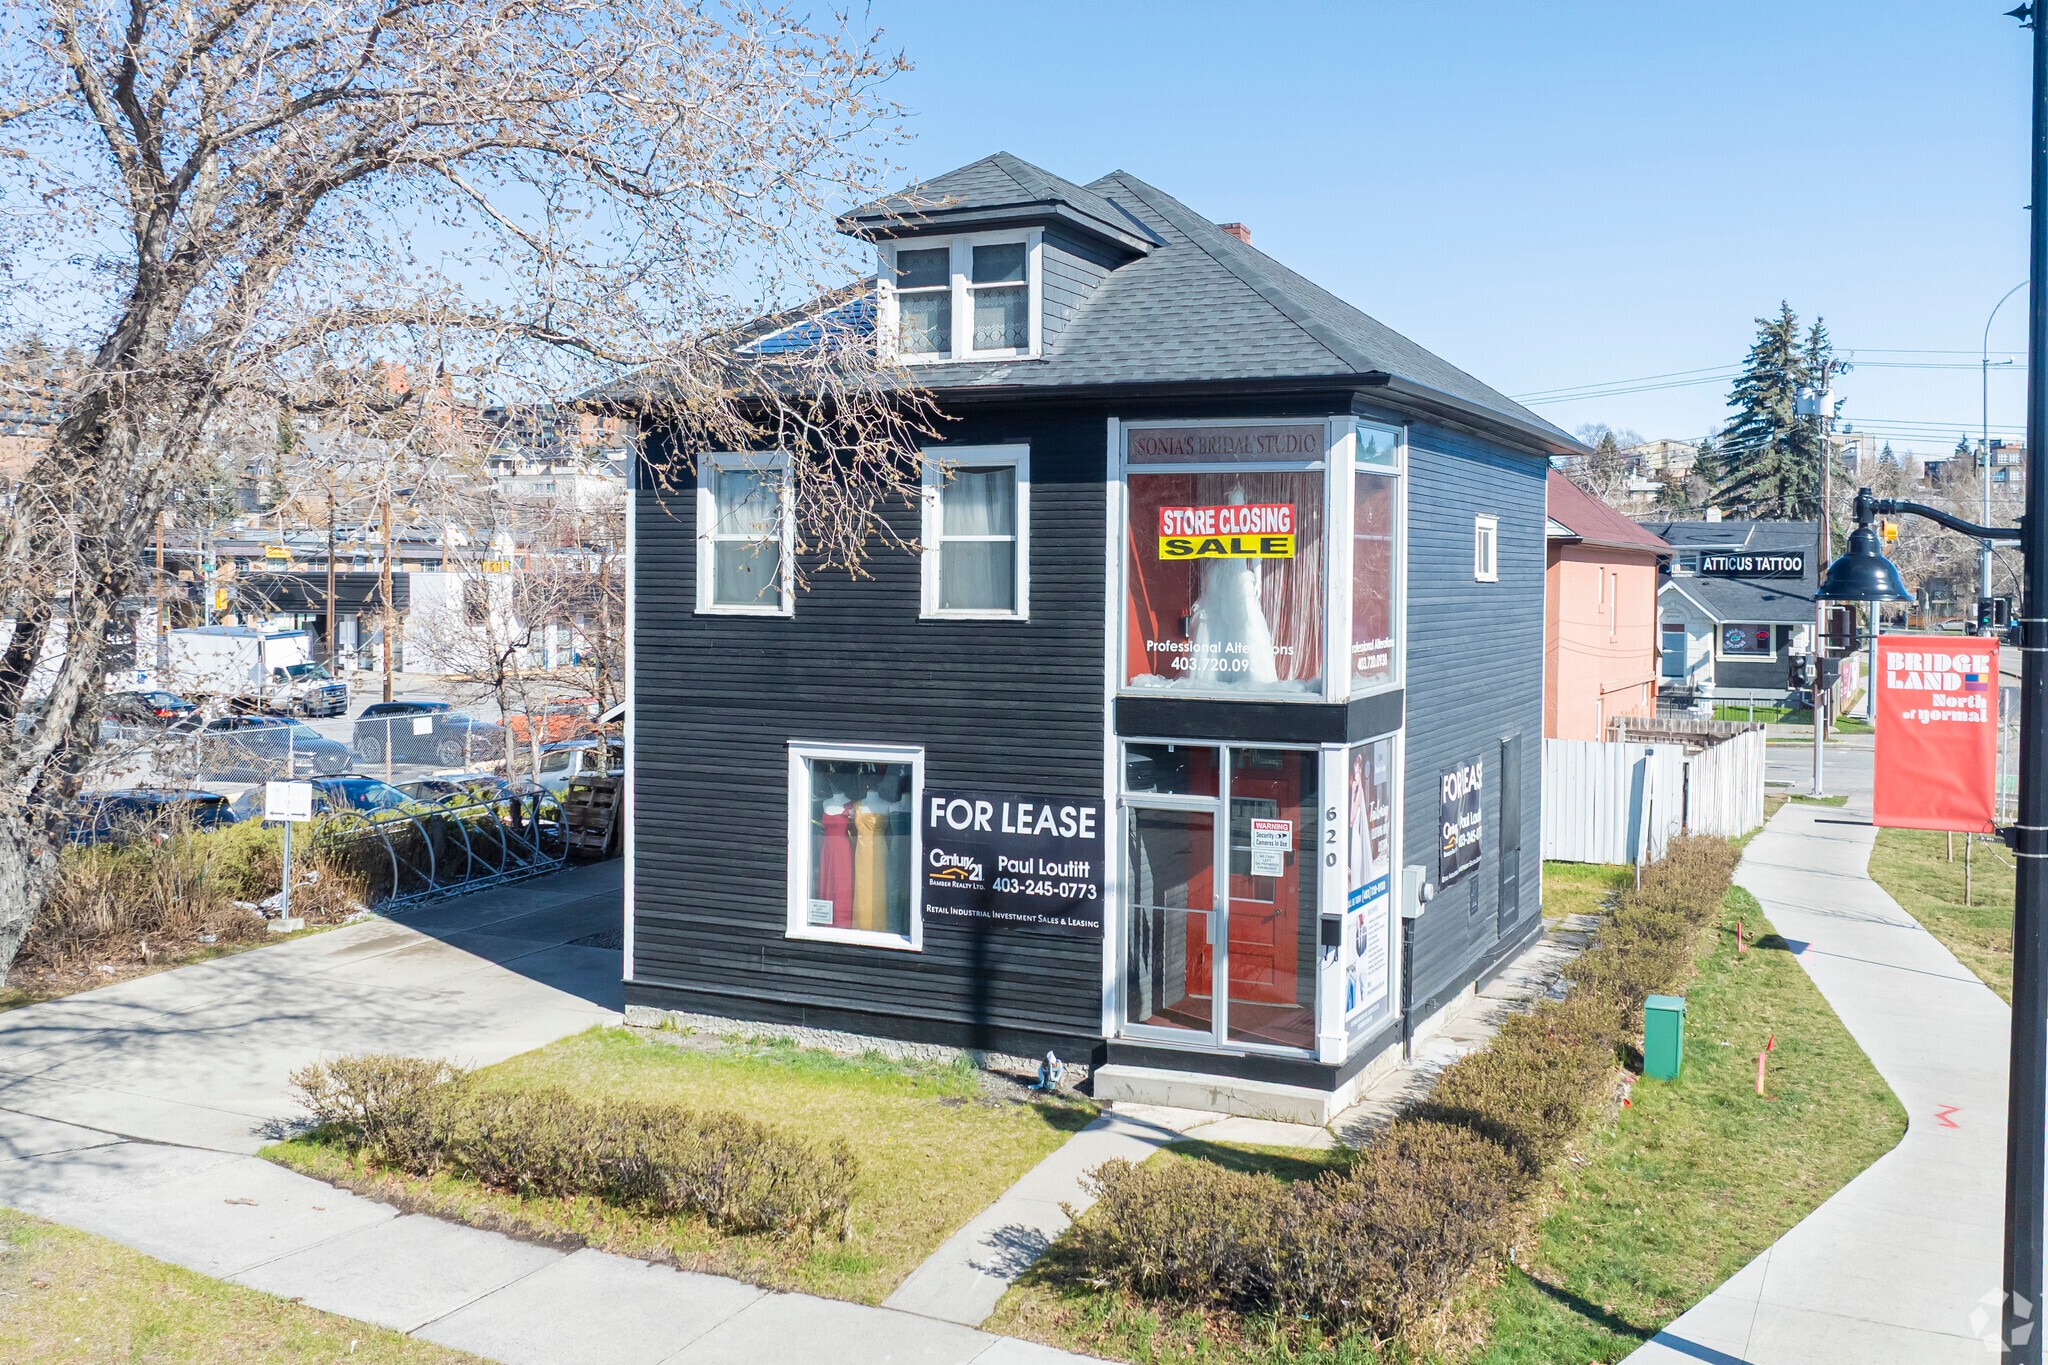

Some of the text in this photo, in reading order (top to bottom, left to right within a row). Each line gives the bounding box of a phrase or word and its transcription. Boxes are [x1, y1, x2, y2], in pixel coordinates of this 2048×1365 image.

[1137, 433, 1316, 456] SONIA'S BRIDAL STUDIO
[1163, 509, 1291, 535] STORE CLOSING
[1165, 537, 1288, 557] SALE
[1703, 557, 1802, 571] ATTICUS TATTOO
[1146, 640, 1294, 656] Professional Alteons
[1171, 657, 1252, 672] 403.720.09
[1886, 652, 1990, 673] BRIDGE
[1886, 671, 1962, 691] LAND
[1932, 693, 1987, 709] North
[1901, 709, 1916, 720] of
[1443, 762, 1483, 804] FOR EAS
[930, 797, 1097, 839] FOR LEASE
[1255, 822, 1289, 831] WARNING
[1256, 831, 1274, 840] Security
[1256, 839, 1274, 847] Cameras
[1280, 840, 1288, 848] Use
[929, 848, 983, 882] Century 21
[998, 856, 1090, 878] Paul Loutitt
[929, 878, 951, 888] BAMBER
[952, 880, 972, 889] REALTY
[992, 877, 1097, 900] 403-245-0773
[926, 904, 1100, 928] RETAIL INDUSTRIAL INVESTMENT SALES & LEASING
